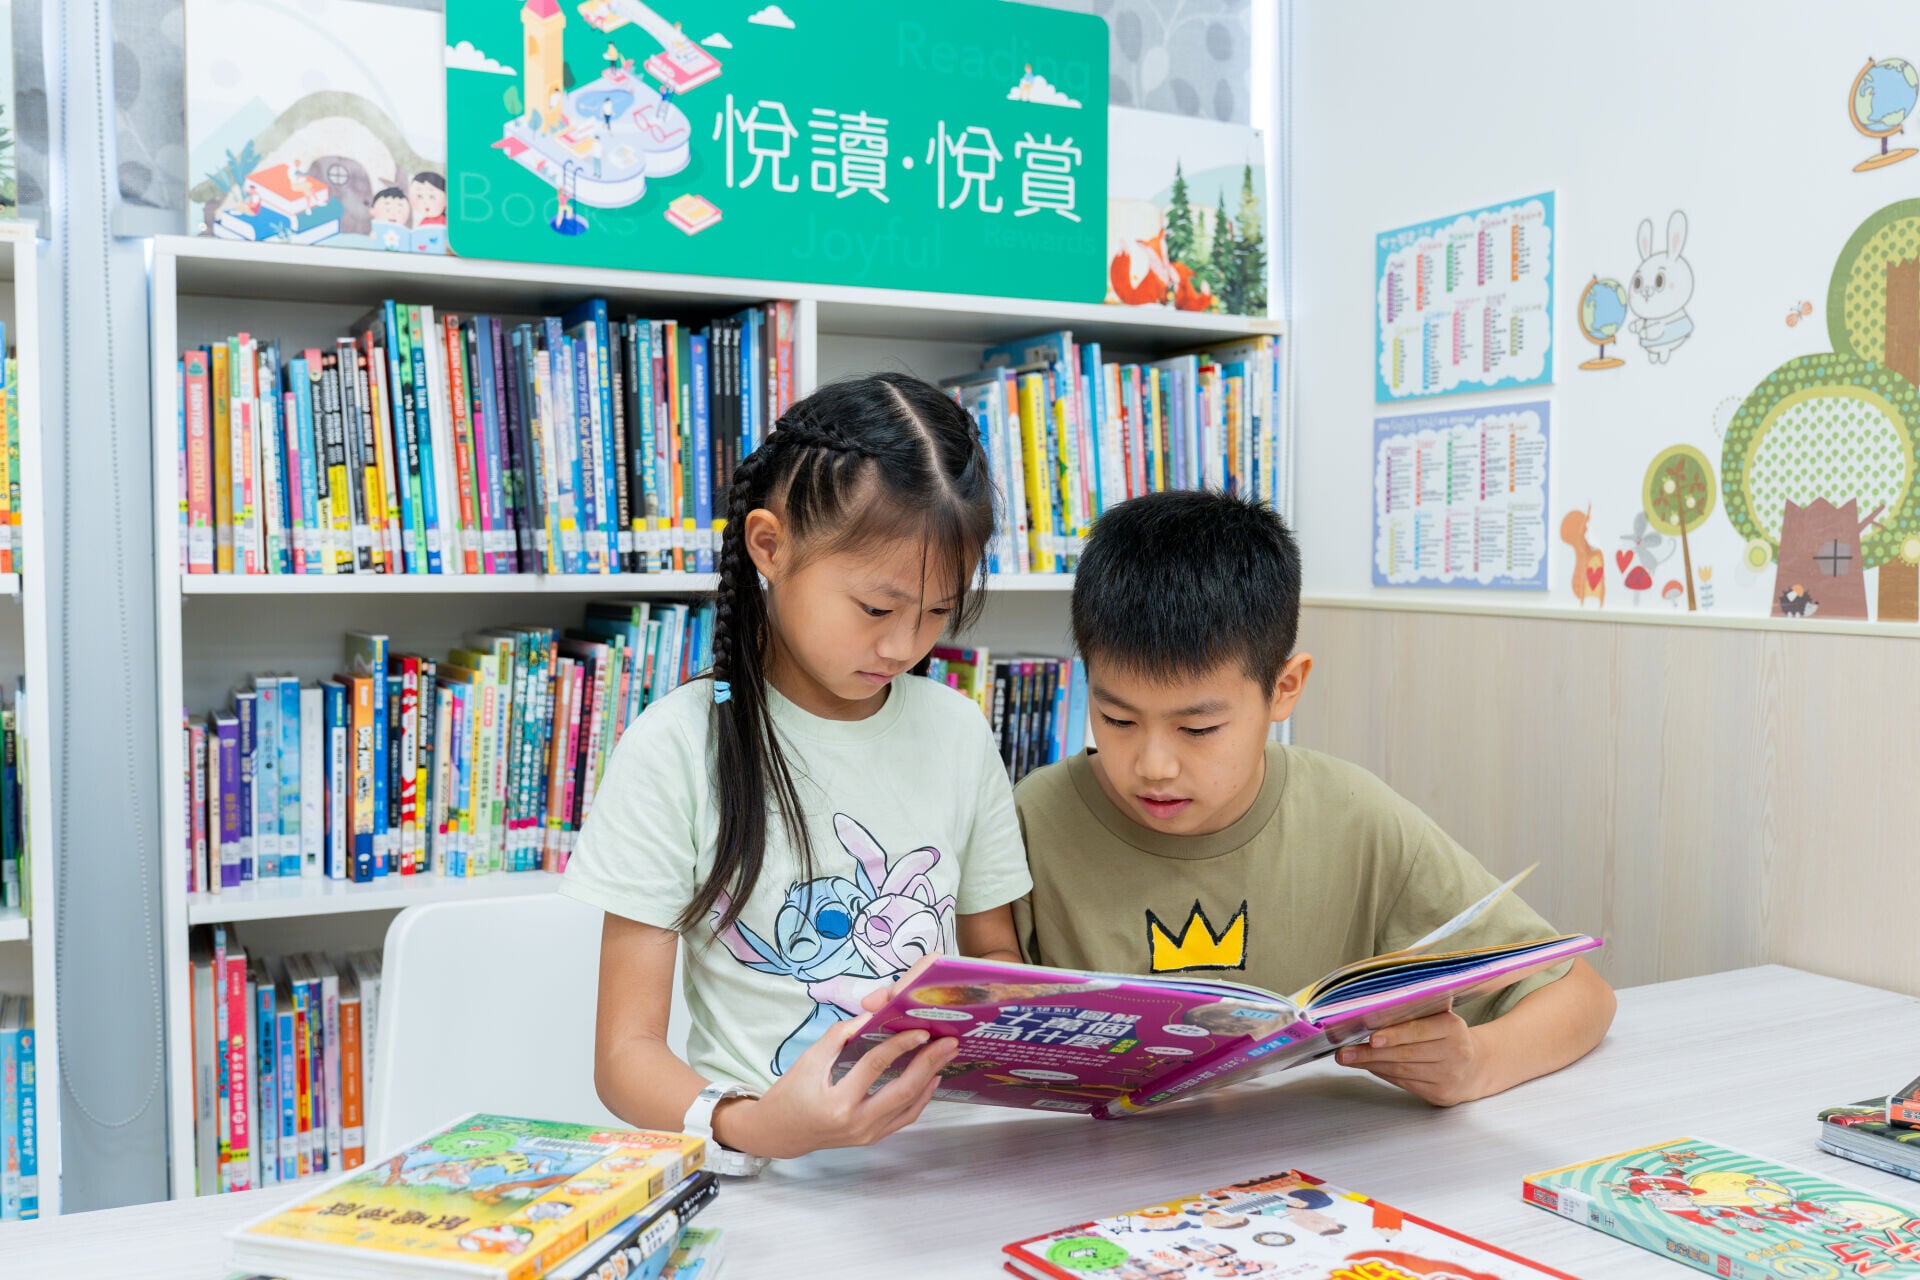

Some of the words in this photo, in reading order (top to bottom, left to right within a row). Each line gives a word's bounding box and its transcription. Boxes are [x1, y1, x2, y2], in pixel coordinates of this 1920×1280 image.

[791, 211, 942, 277] Joyful
[984, 219, 1097, 257] Rewards
[640, 342, 650, 384] Questions
[580, 417, 591, 437] Our
[641, 397, 652, 433] Answers
[582, 439, 594, 470] World
[643, 442, 654, 466] Long
[192, 439, 206, 502] CHRISTMAS
[489, 455, 499, 482] Painting
[646, 468, 657, 488] Ago
[584, 471, 596, 498] book
[492, 490, 502, 518] Drawing
[619, 498, 628, 526] CLASS
[962, 1022, 1117, 1050] 為什麼
[1000, 1012, 1133, 1037] 十萬個
